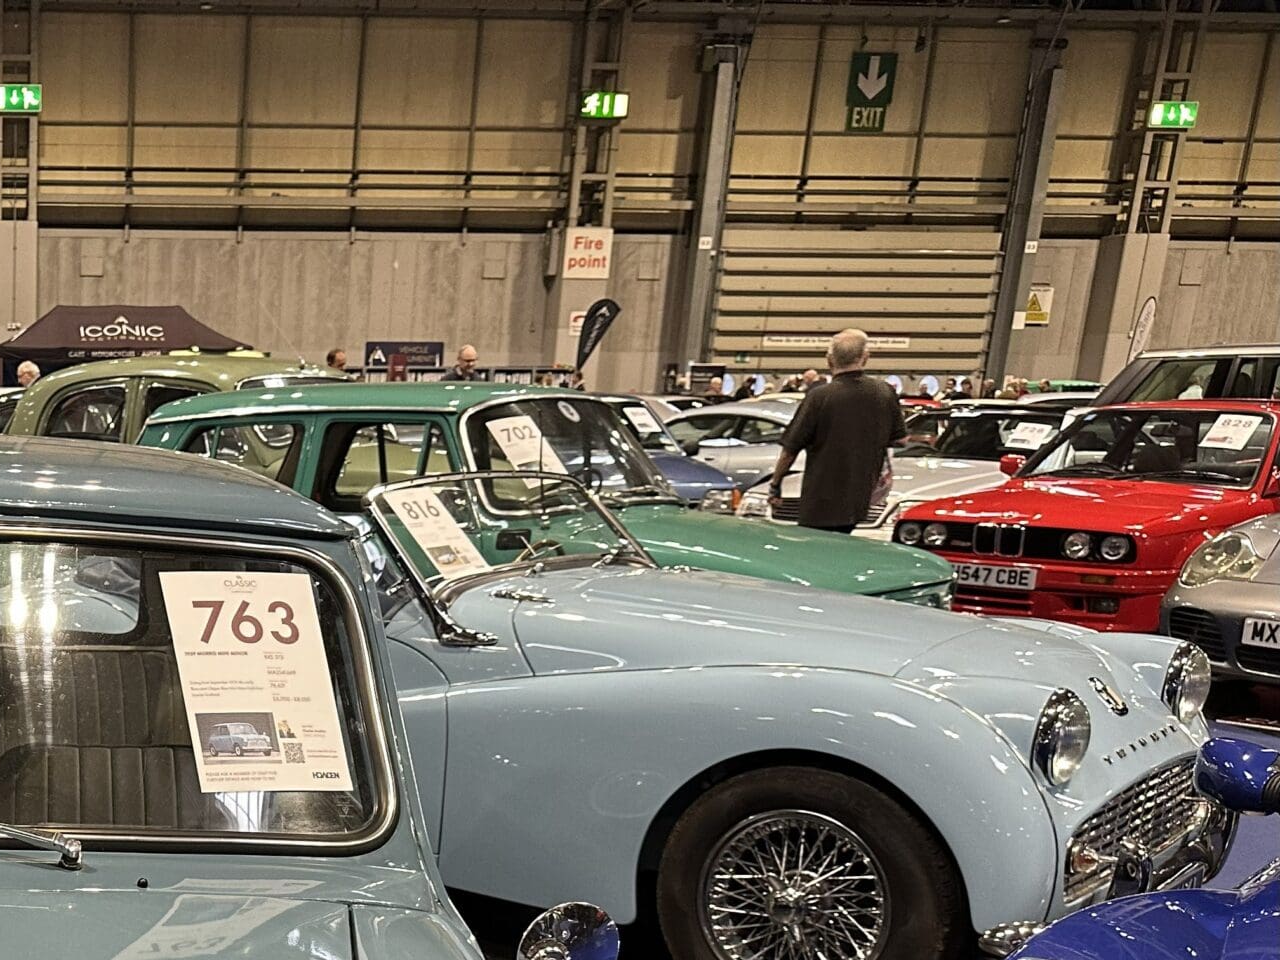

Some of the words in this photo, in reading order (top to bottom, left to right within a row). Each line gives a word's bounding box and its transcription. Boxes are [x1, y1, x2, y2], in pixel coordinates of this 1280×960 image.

[851, 107, 884, 128] EXIT
[573, 236, 604, 250] Fire
[567, 255, 607, 270] point
[79, 324, 165, 338] ICONIC
[1220, 418, 1254, 428] 828
[500, 425, 537, 443] 702
[401, 499, 440, 520] 816
[995, 569, 1031, 586] CBE
[191, 599, 300, 645] 763
[1251, 621, 1280, 644] MX
